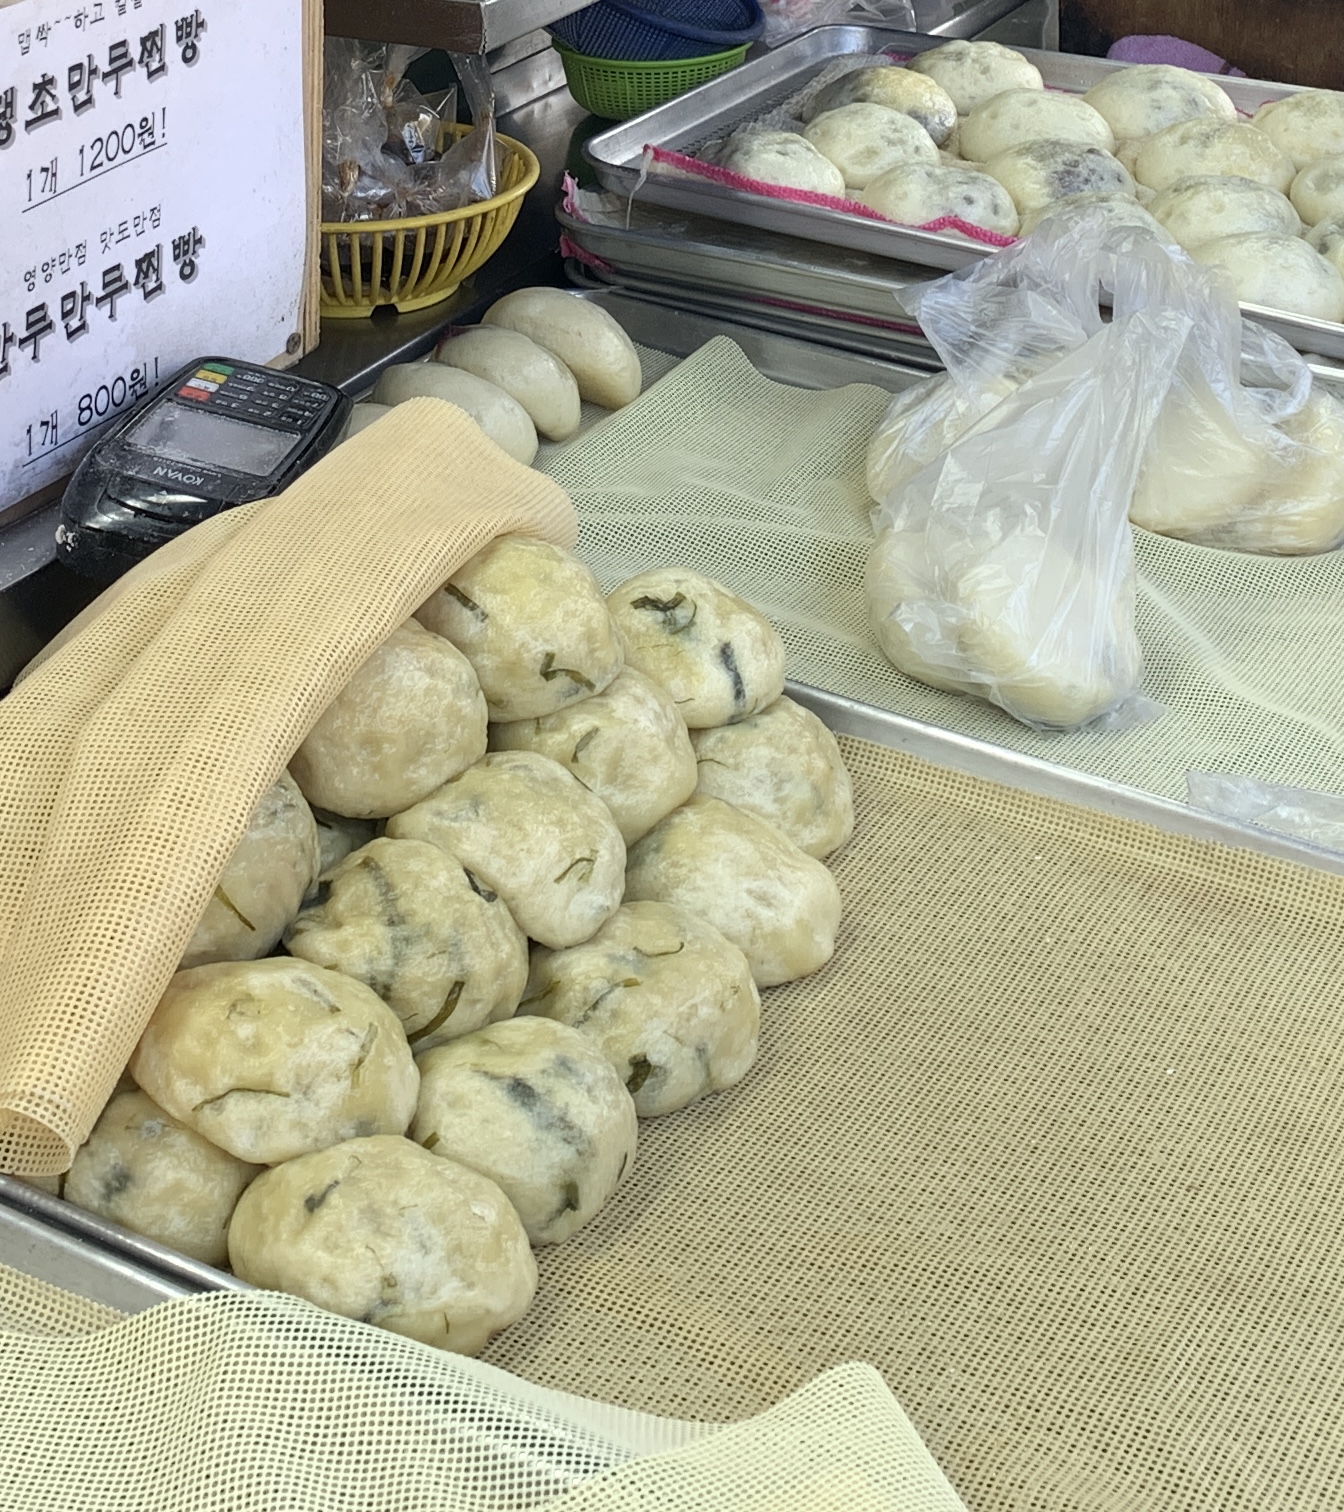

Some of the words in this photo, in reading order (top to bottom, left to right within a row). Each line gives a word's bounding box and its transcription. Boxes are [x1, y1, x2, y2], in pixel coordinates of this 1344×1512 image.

[27, 157, 58, 202] 1개
[79, 107, 167, 177] 1200원!
[23, 239, 87, 293] 영양만점
[100, 203, 162, 254] 맛도만점
[26, 410, 58, 457] 1개
[77, 357, 159, 426] 800원!
[153, 466, 204, 486] KOVAN
